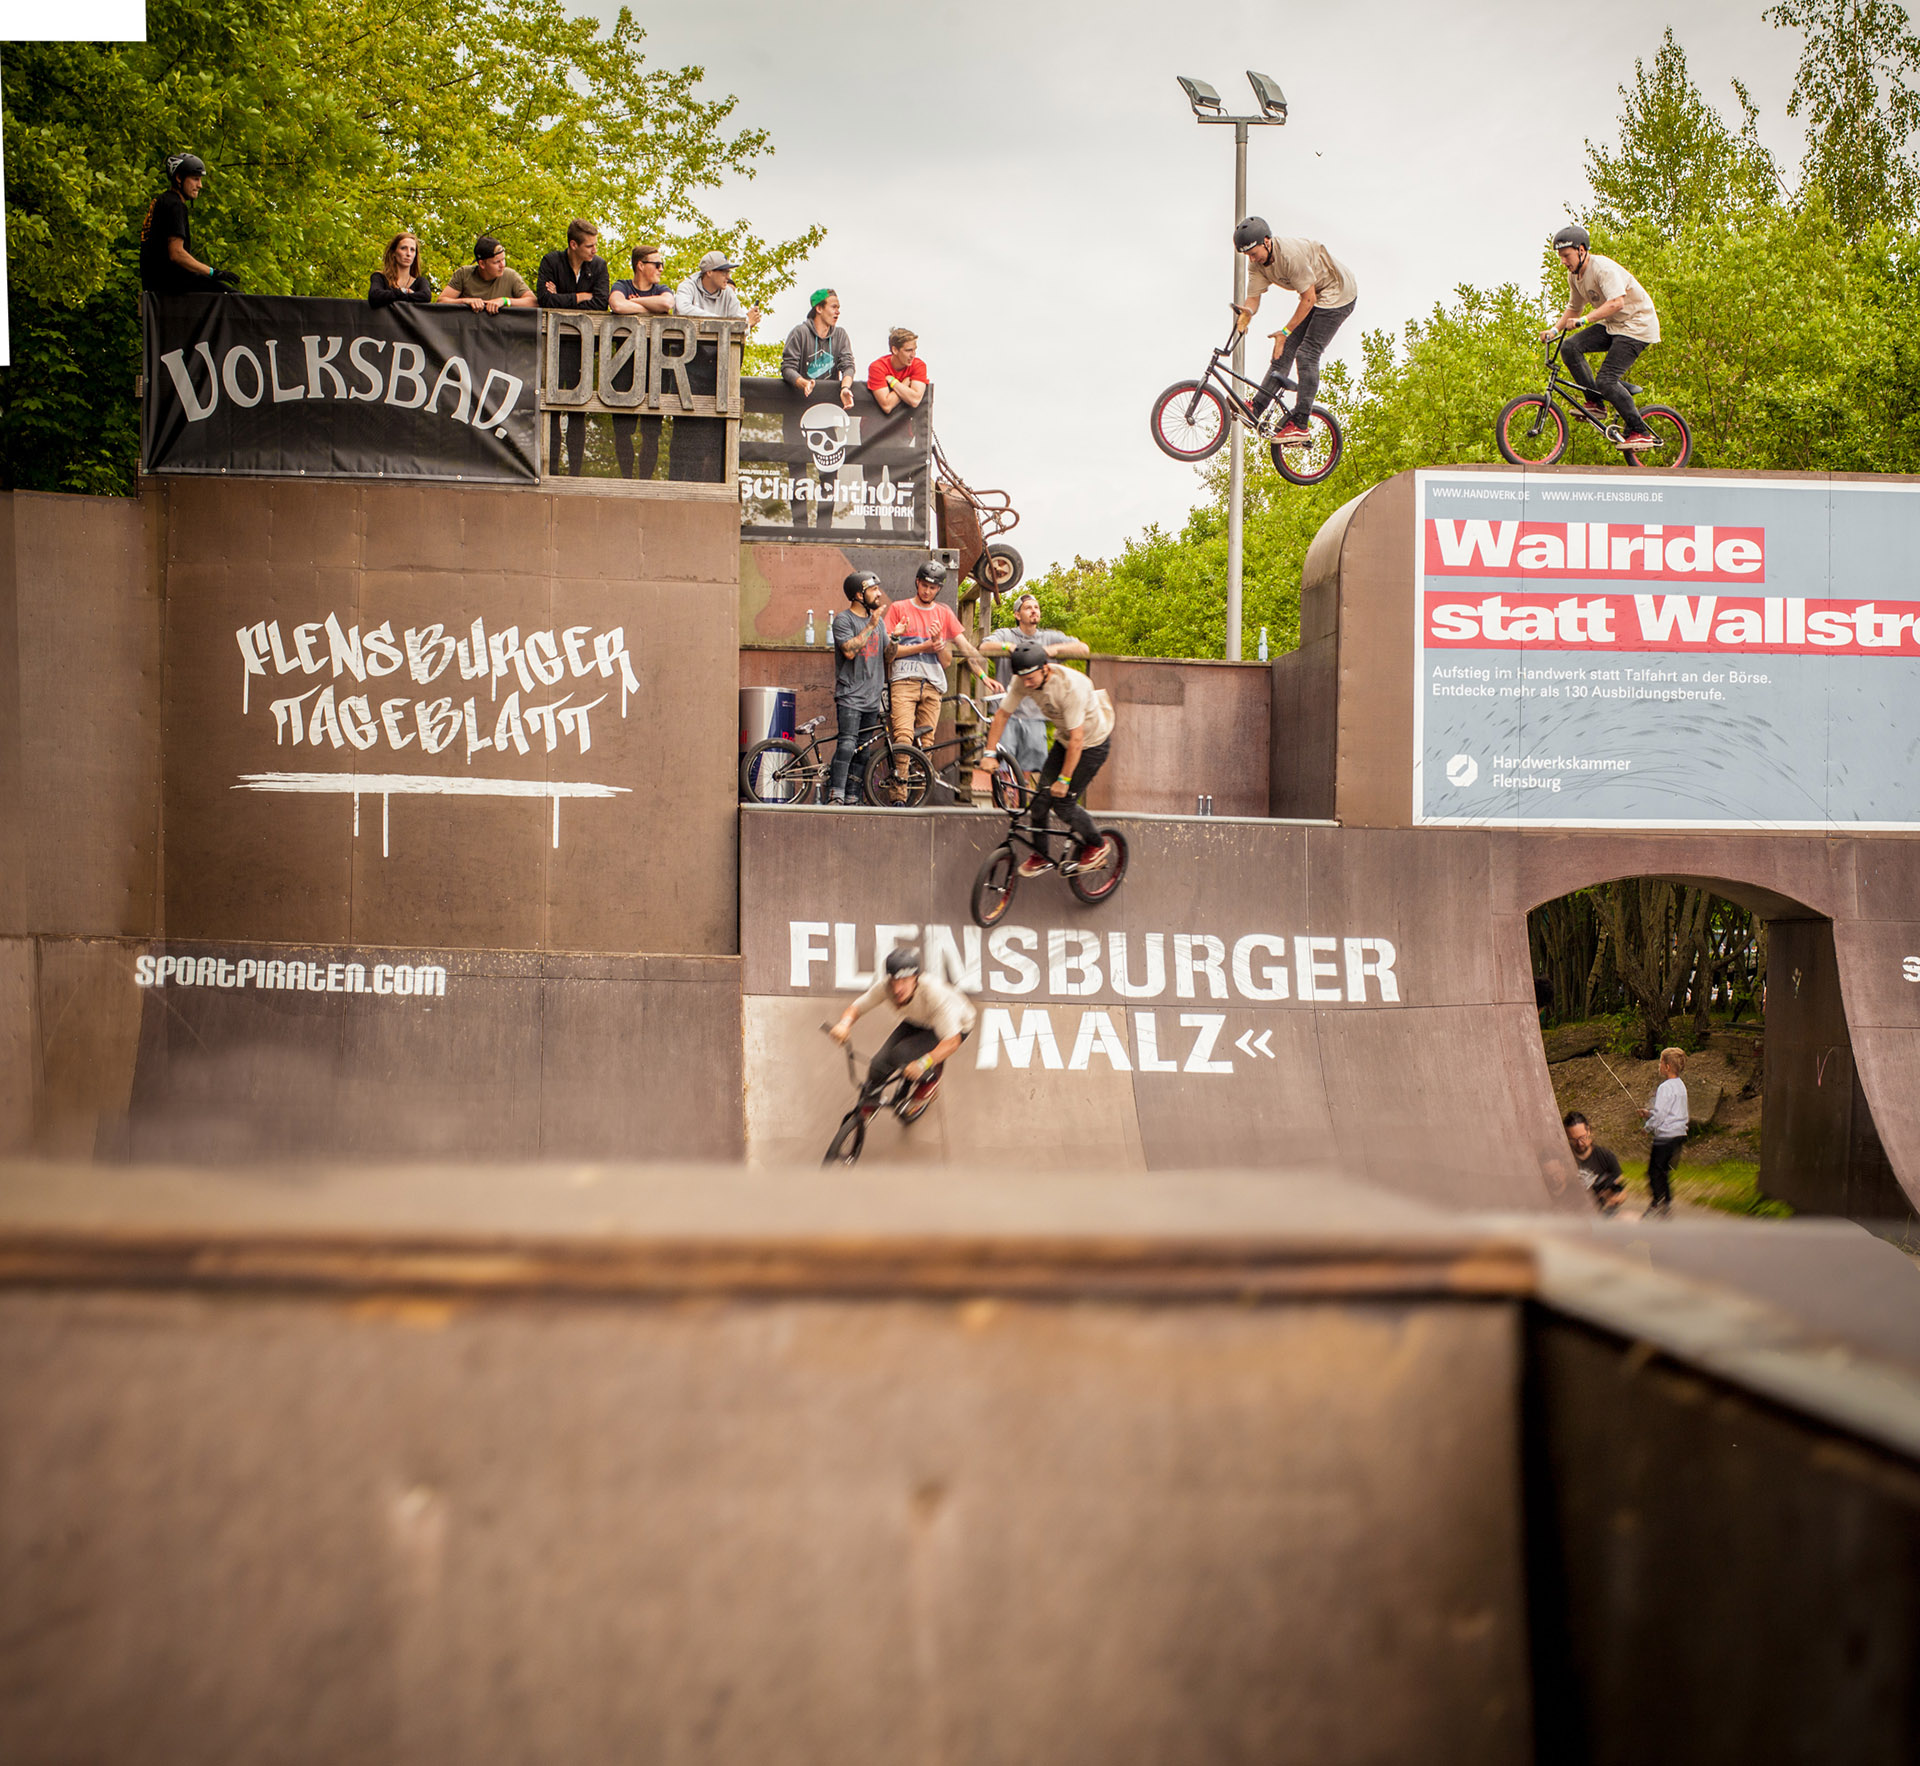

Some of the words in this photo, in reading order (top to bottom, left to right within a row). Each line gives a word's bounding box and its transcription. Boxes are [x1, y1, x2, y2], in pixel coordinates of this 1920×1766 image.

[1432, 488, 1530, 501] WWW.HANDWERK.DE
[1541, 491, 1664, 503] WWW.HWK-FLENSBURG.DE
[1433, 518, 1762, 574] Wallride
[1431, 596, 1616, 642] statt
[1633, 594, 1920, 648] Wallstr
[235, 611, 641, 704] FLENSBURGER
[1432, 666, 1490, 681] Aufstieg
[1495, 667, 1512, 680] im
[1517, 667, 1586, 681] Handwerk
[1590, 668, 1620, 681] statt
[1624, 668, 1678, 682] Talfahrt
[1681, 672, 1698, 683] an
[1702, 670, 1727, 684] der
[1729, 670, 1772, 684] Börse.
[1432, 684, 1496, 697] Entdecke
[1500, 685, 1536, 698] mehr
[1540, 685, 1560, 698] als
[1564, 686, 1588, 698] 130
[1591, 686, 1726, 702] Ausbildungsberufe.
[269, 684, 609, 762] TAGEBLATT
[1493, 755, 1631, 771] Handwerkskammer
[1493, 775, 1561, 792] Flensburg
